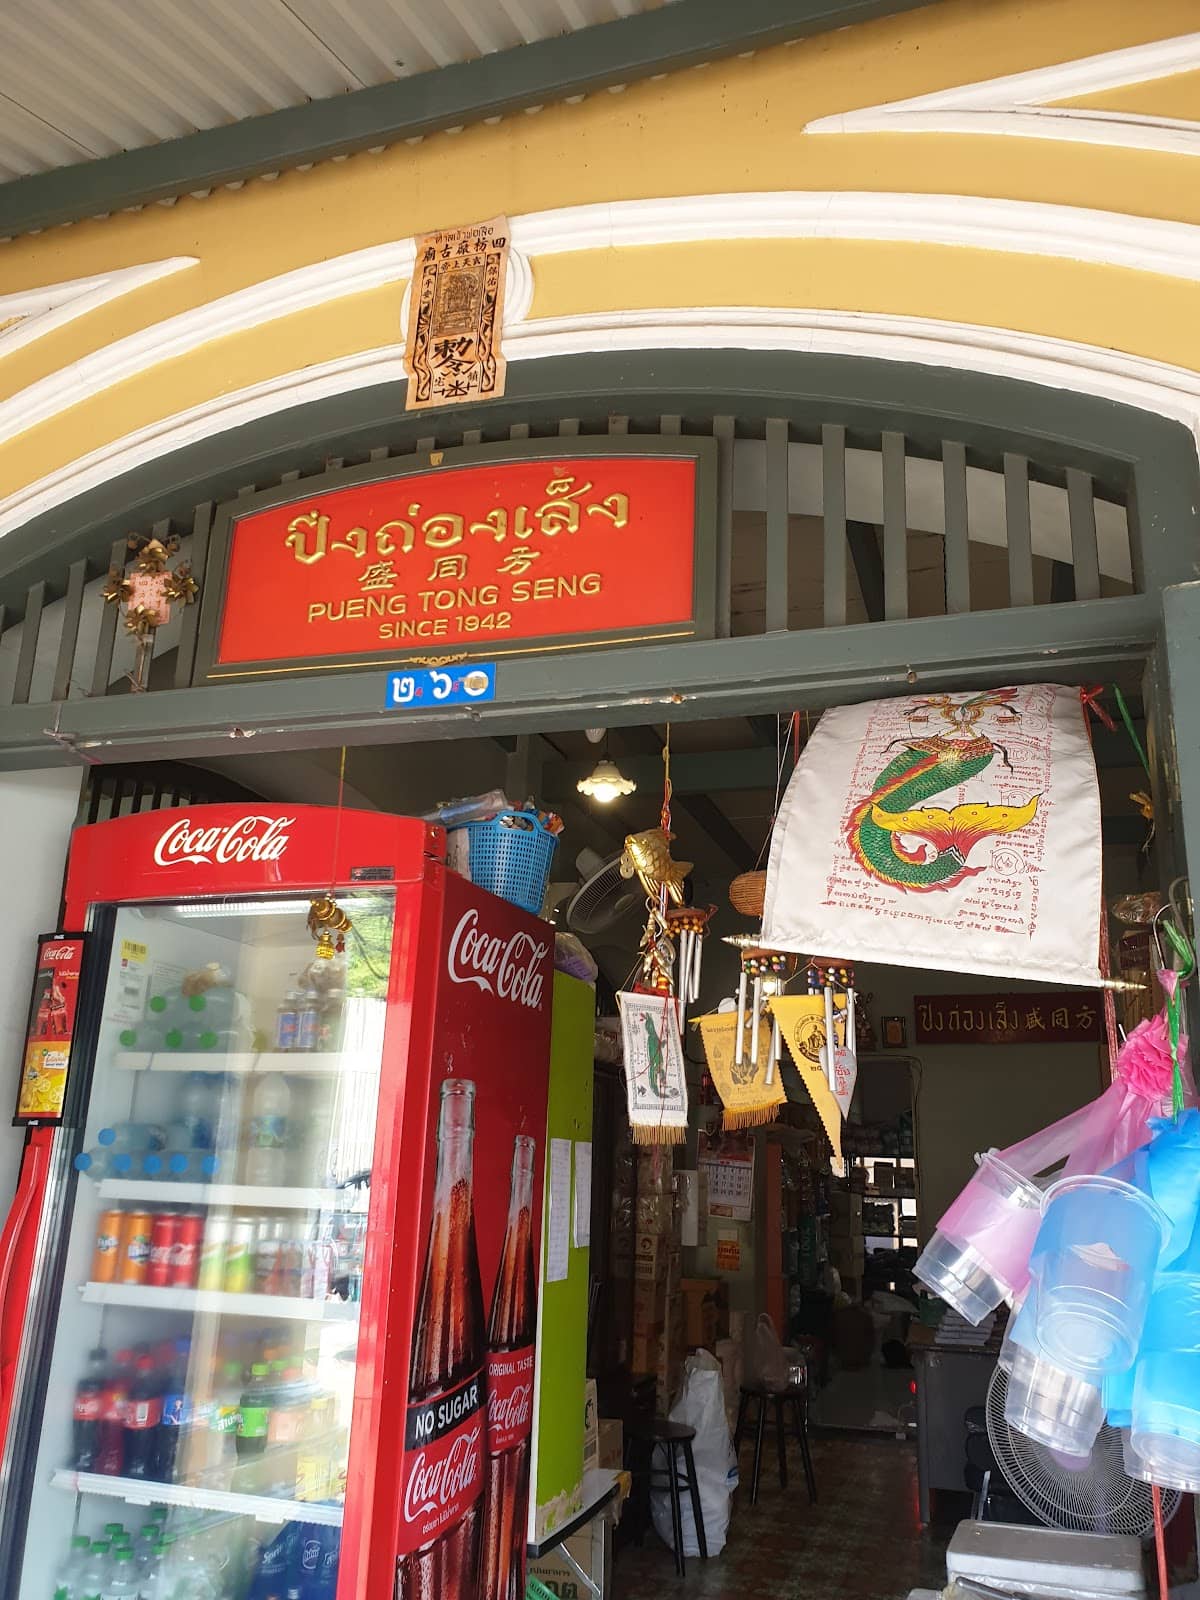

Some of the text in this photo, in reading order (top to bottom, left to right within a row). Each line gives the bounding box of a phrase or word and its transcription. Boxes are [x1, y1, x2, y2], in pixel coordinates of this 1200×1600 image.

[307, 573, 602, 623] PUENG TONG SENG
[379, 612, 512, 639] SINCE 1942
[153, 816, 296, 866] Coca-Cola
[448, 909, 549, 1009] Coca-Cola
[488, 1356, 534, 1377] ORIGINAL TASTE
[415, 1385, 477, 1440] NO SUGAR
[404, 1425, 481, 1523] Coca-Cola
